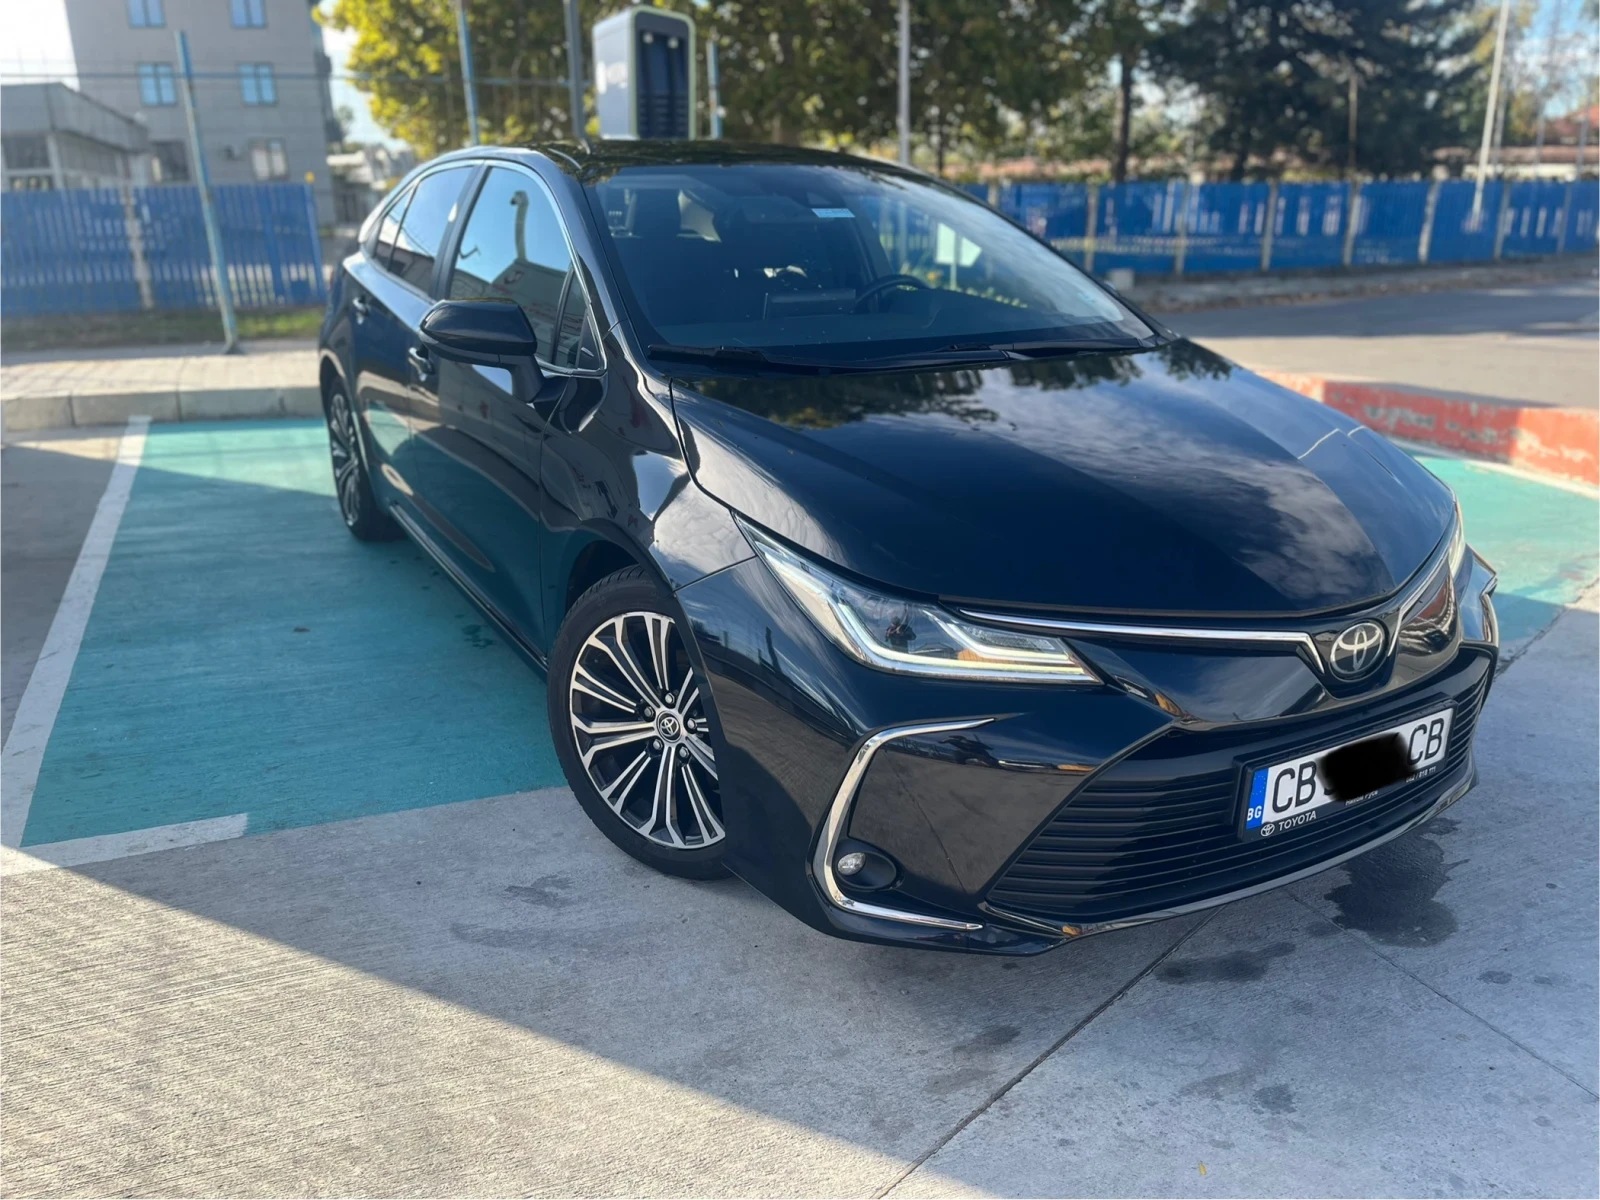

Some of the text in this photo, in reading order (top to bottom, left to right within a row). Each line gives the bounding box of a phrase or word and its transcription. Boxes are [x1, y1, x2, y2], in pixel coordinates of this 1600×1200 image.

[1272, 761, 1317, 814] CB
[1407, 717, 1445, 766] CB
[1246, 805, 1262, 821] BG
[1279, 810, 1317, 831] TOYOTA
